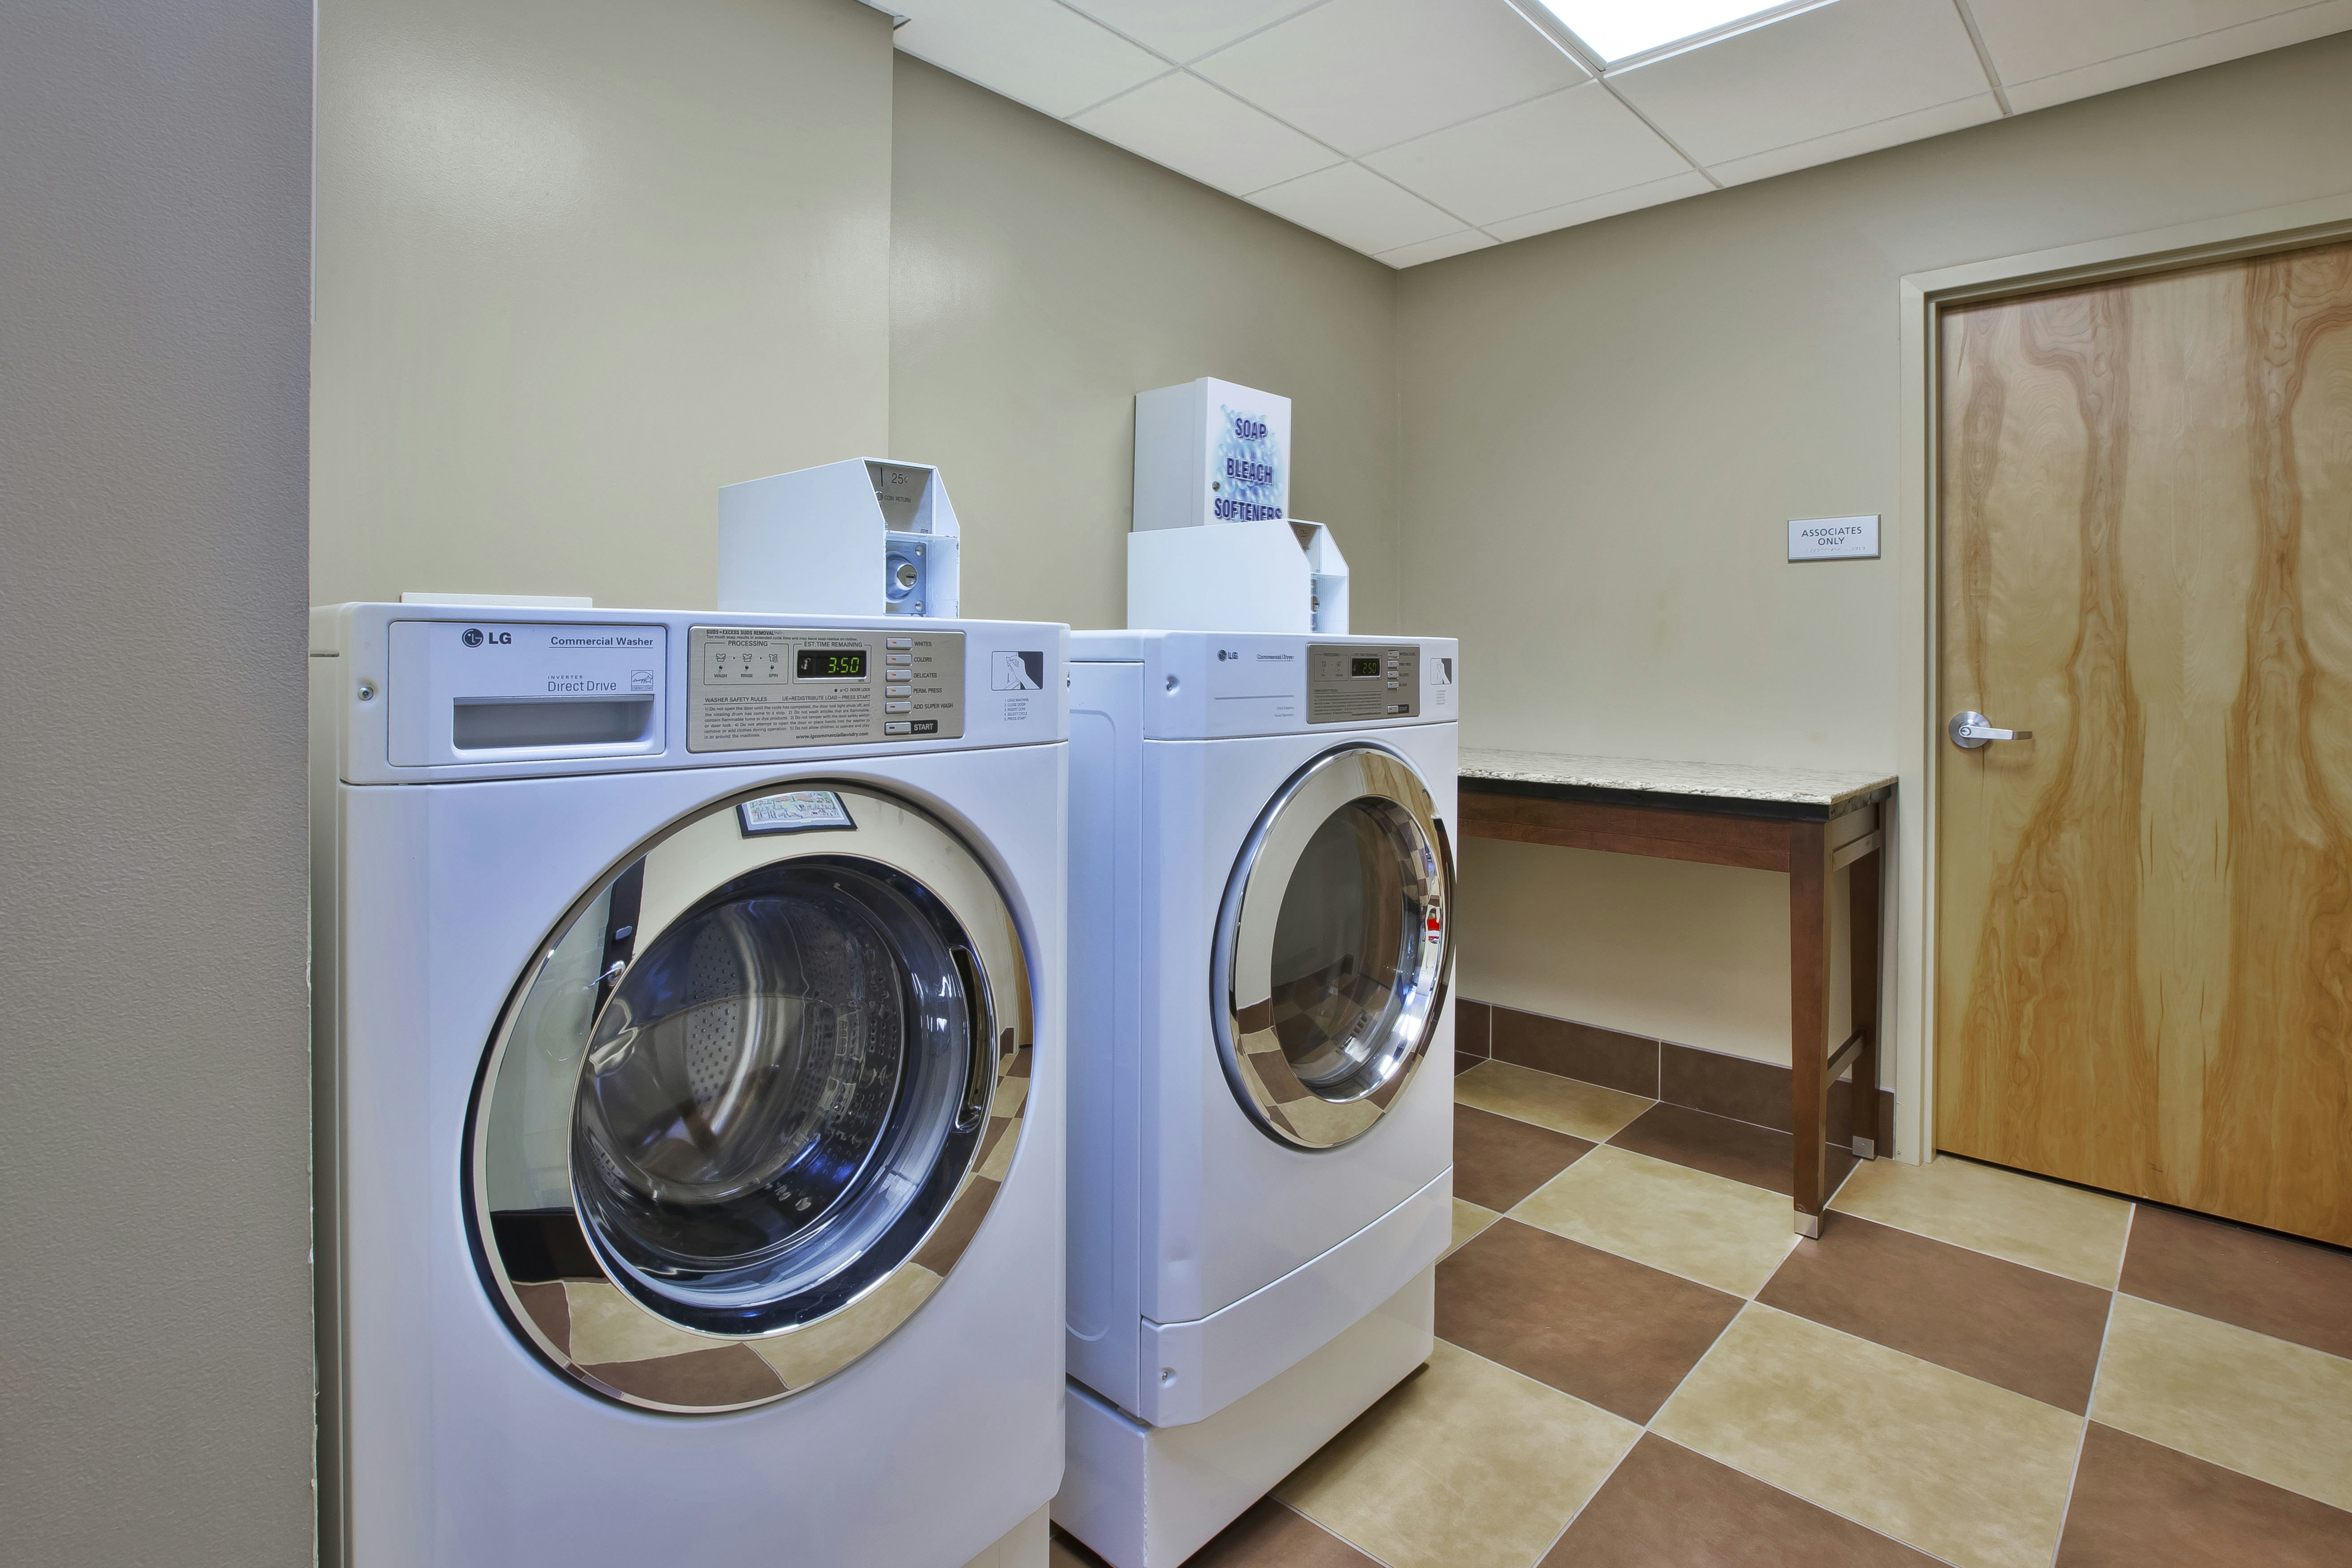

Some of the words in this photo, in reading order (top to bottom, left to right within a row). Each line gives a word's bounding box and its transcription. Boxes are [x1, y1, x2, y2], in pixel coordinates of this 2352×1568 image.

[1235, 417, 1267, 440] SOAP
[1226, 457, 1273, 484] BLEACH
[1214, 497, 1282, 521] SOFTENERS
[1801, 526, 1862, 537] ASSOCIATES
[1818, 537, 1845, 545] ONLY
[489, 632, 512, 644] LG
[551, 636, 613, 645] Commercial
[616, 637, 653, 646] Washer
[1228, 651, 1238, 660] LG
[828, 657, 860, 673] 3.50
[548, 681, 584, 691] Direct
[587, 681, 616, 691] Drive
